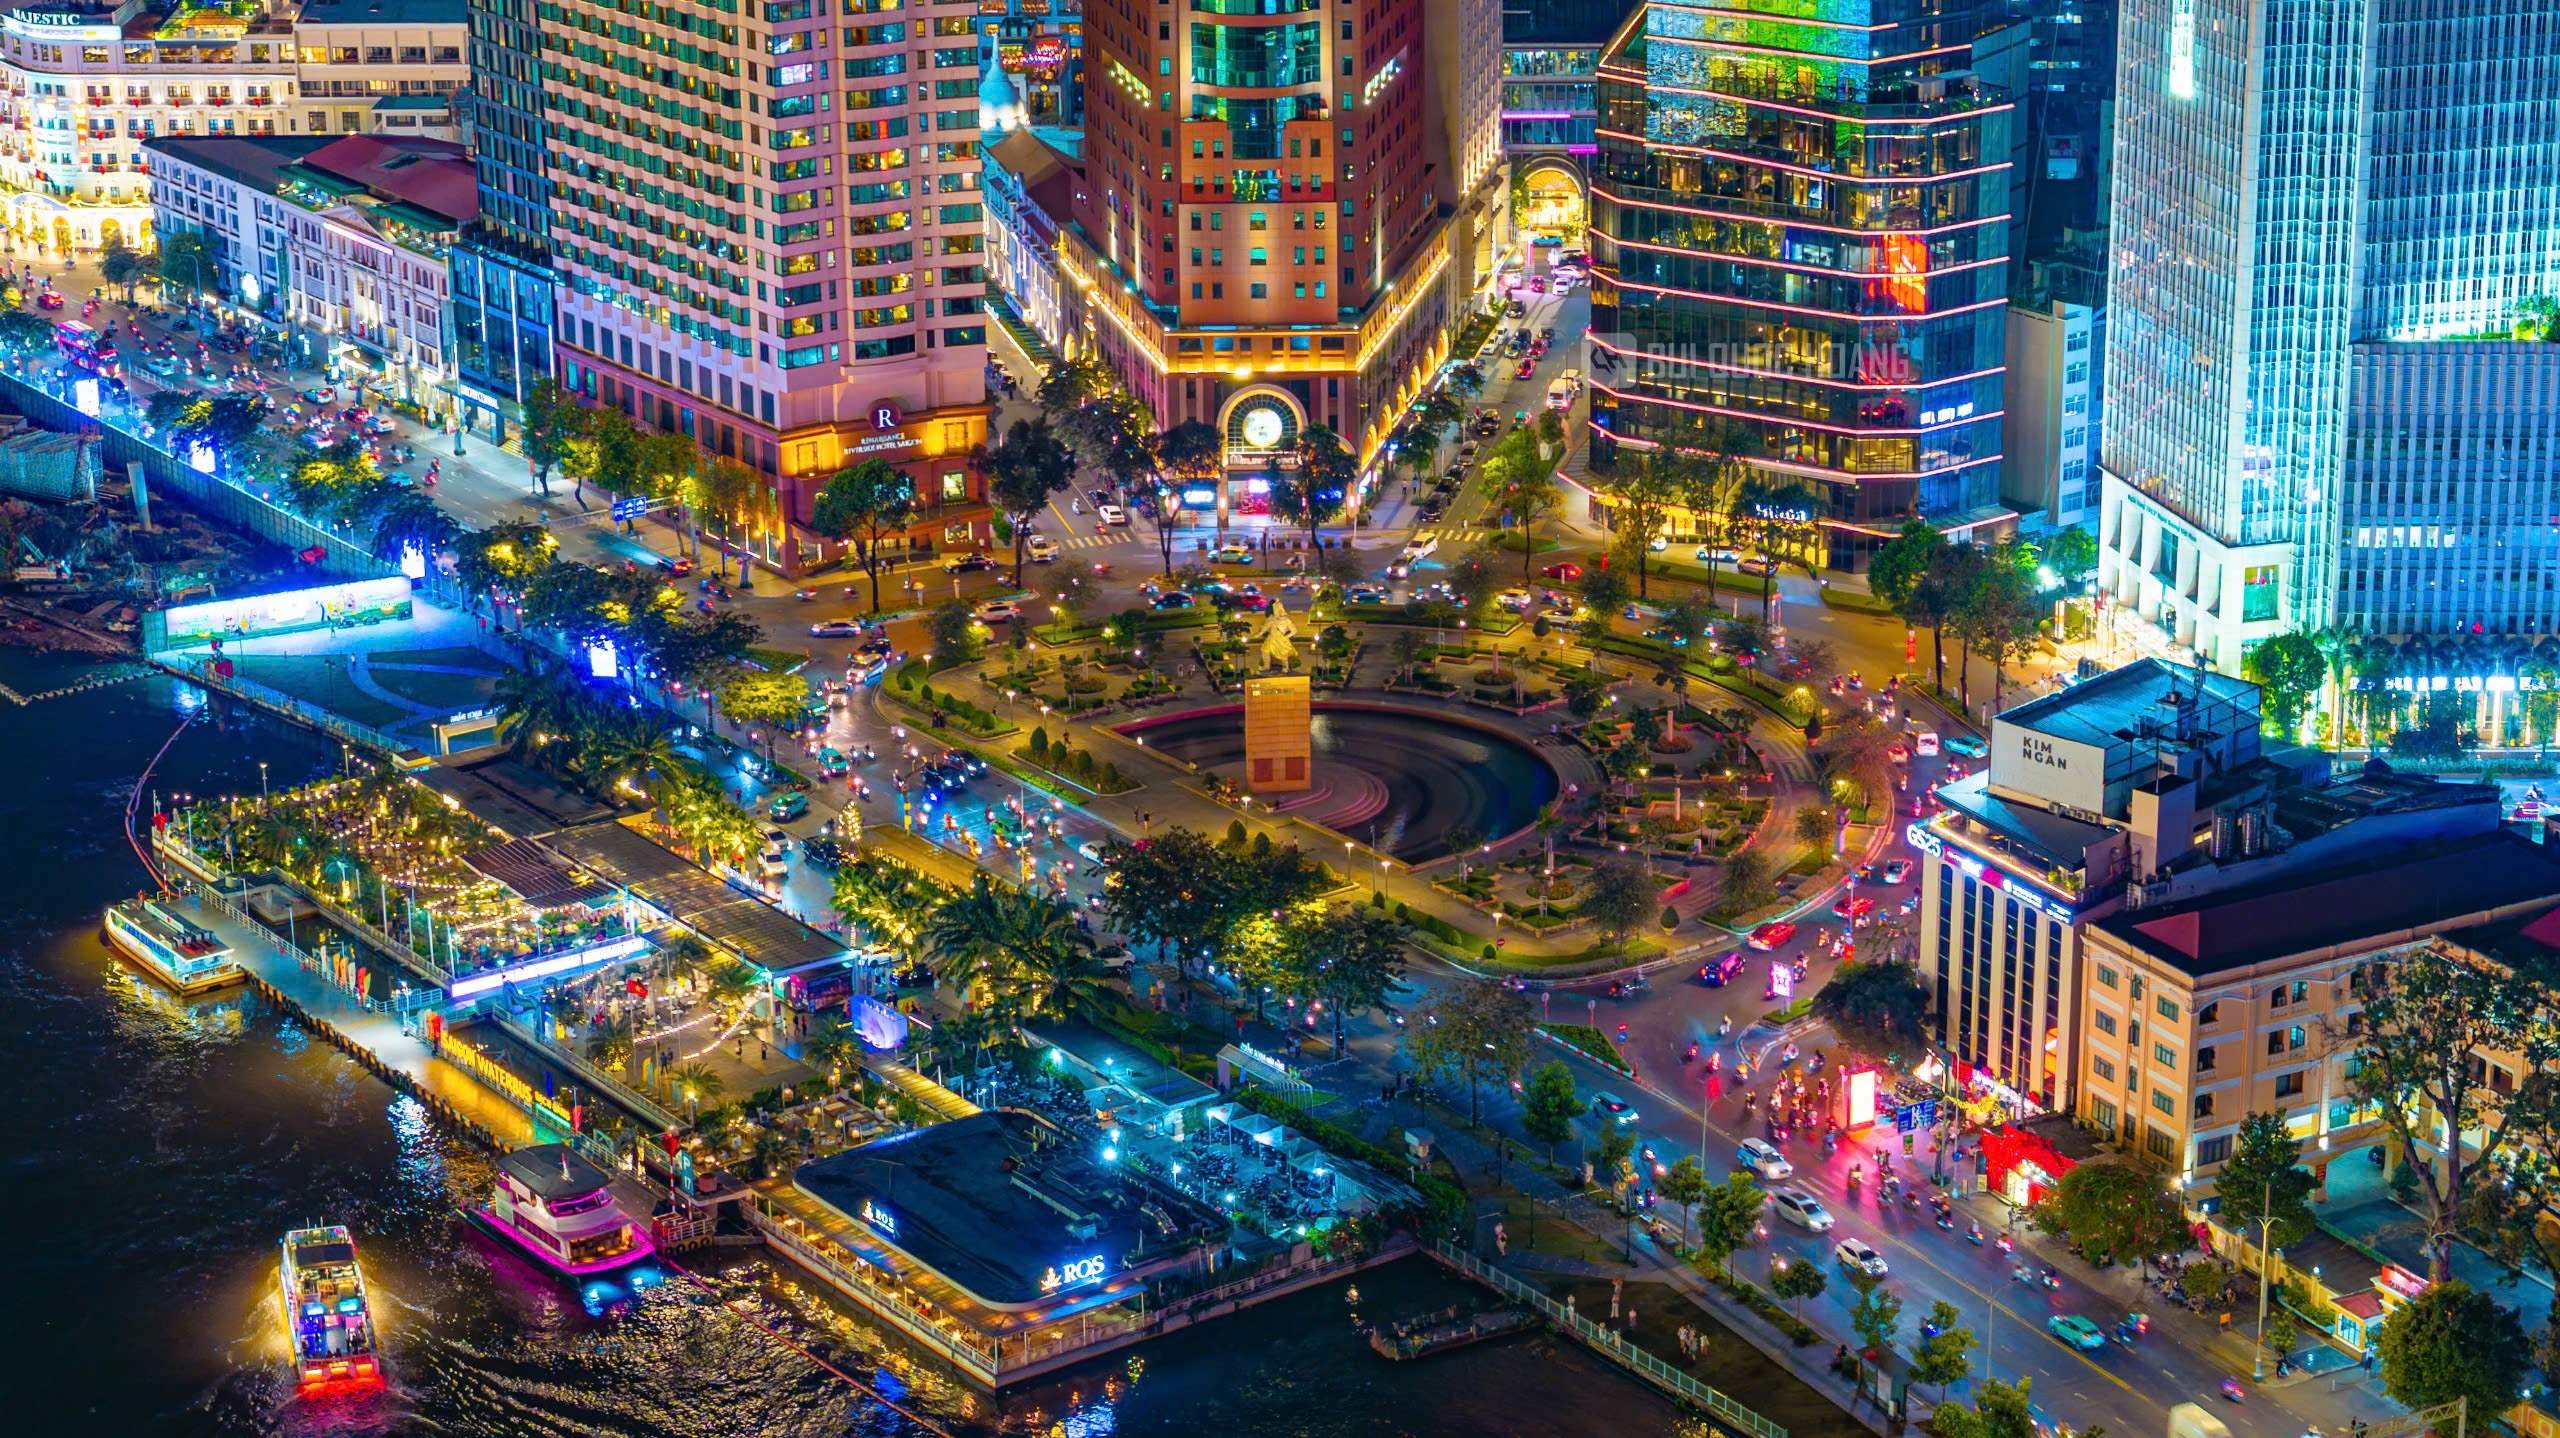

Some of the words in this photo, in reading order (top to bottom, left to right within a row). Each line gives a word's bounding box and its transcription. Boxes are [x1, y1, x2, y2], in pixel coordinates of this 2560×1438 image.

[12, 8, 80, 25] MAJESTIC
[878, 409, 895, 428] R
[2023, 736, 2052, 754] KIM
[2022, 748, 2066, 770] NGAN
[1907, 824, 1942, 858] GS25
[441, 1031, 476, 1067] SAIGON
[476, 1053, 533, 1104] WATERBUS
[875, 1208, 895, 1228] ROS
[1063, 1254, 1105, 1284] ROS
